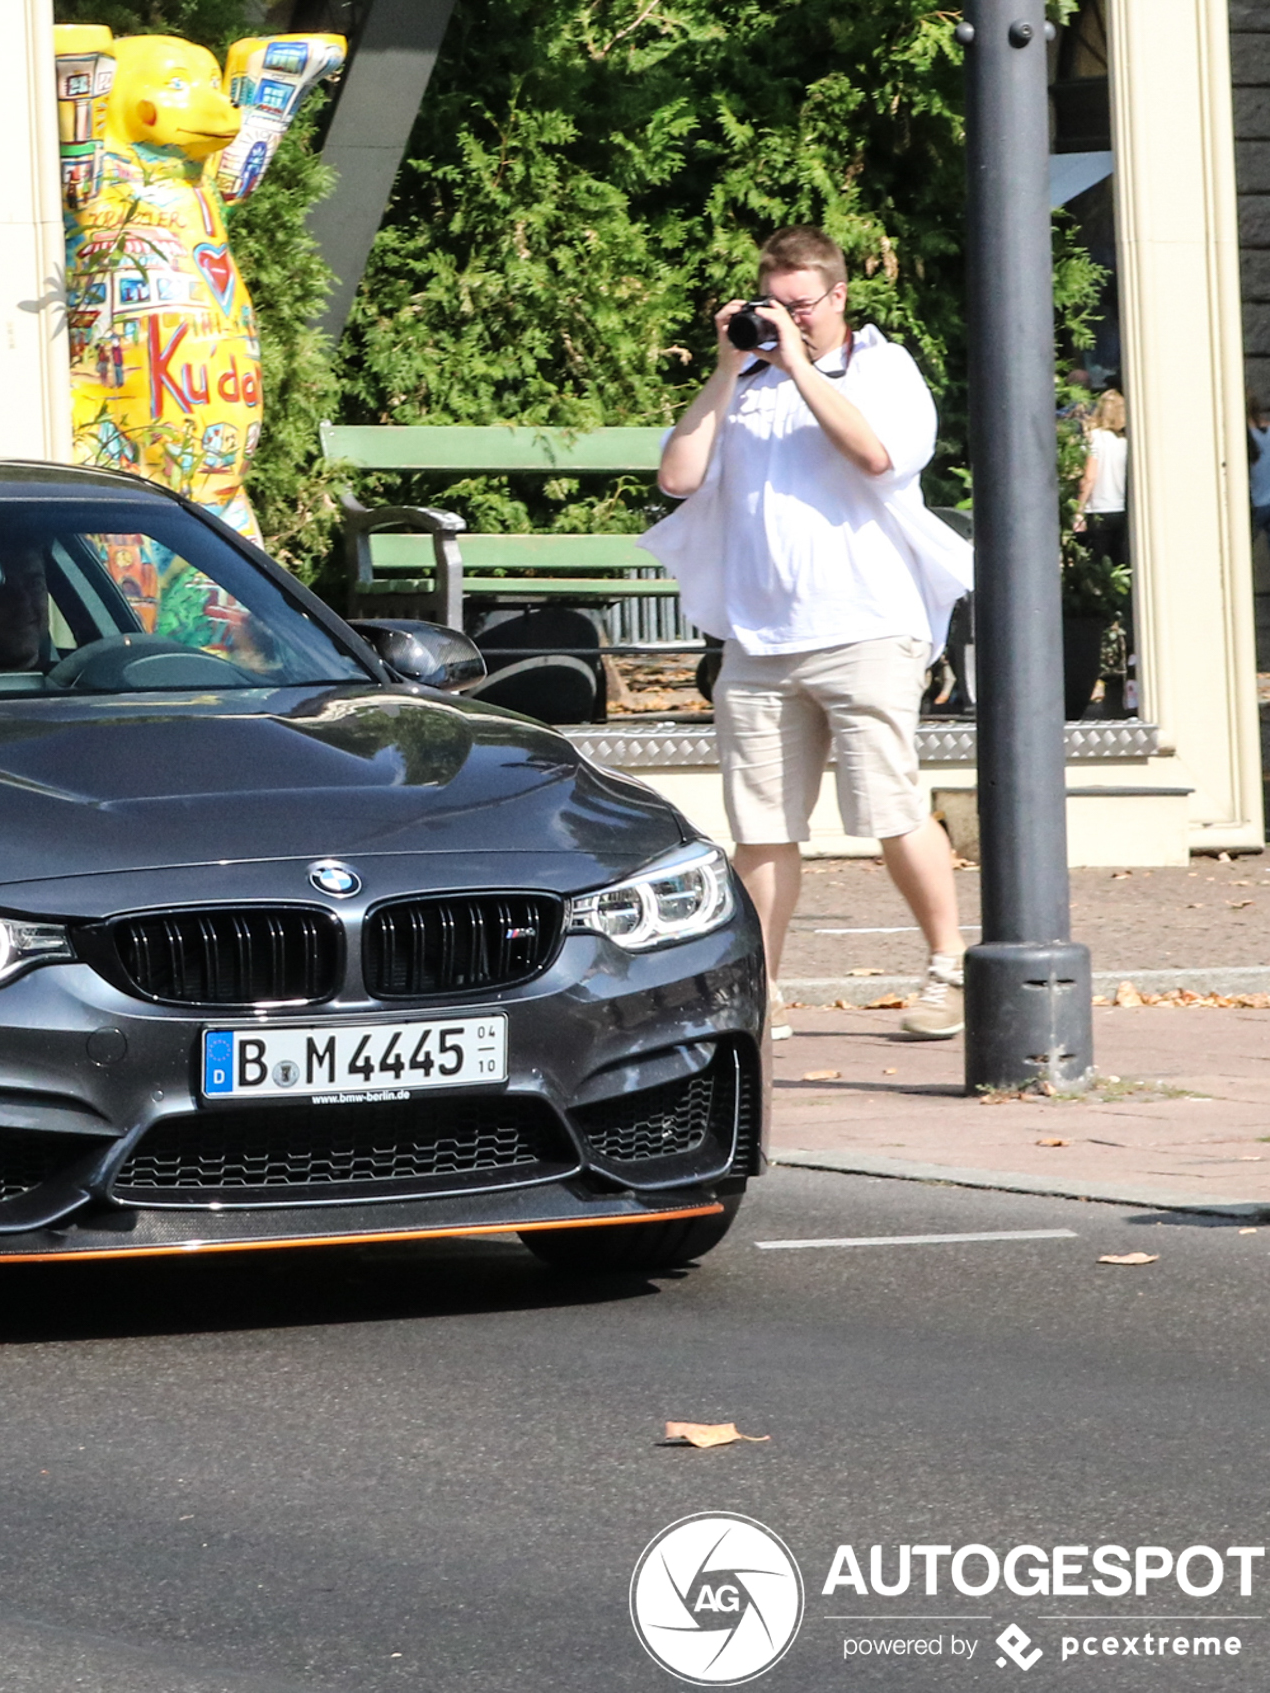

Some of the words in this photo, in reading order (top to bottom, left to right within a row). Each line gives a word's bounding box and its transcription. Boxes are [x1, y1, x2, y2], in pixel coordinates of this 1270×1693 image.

[88, 209, 187, 230] KRAZLER
[477, 1025, 497, 1040] 04
[238, 1039, 268, 1087] B
[306, 1036, 336, 1084] M
[348, 1027, 465, 1082] 4445
[478, 1059, 496, 1074] 10
[213, 1069, 226, 1085] D
[311, 1089, 411, 1105] www.bmw-berlin.de
